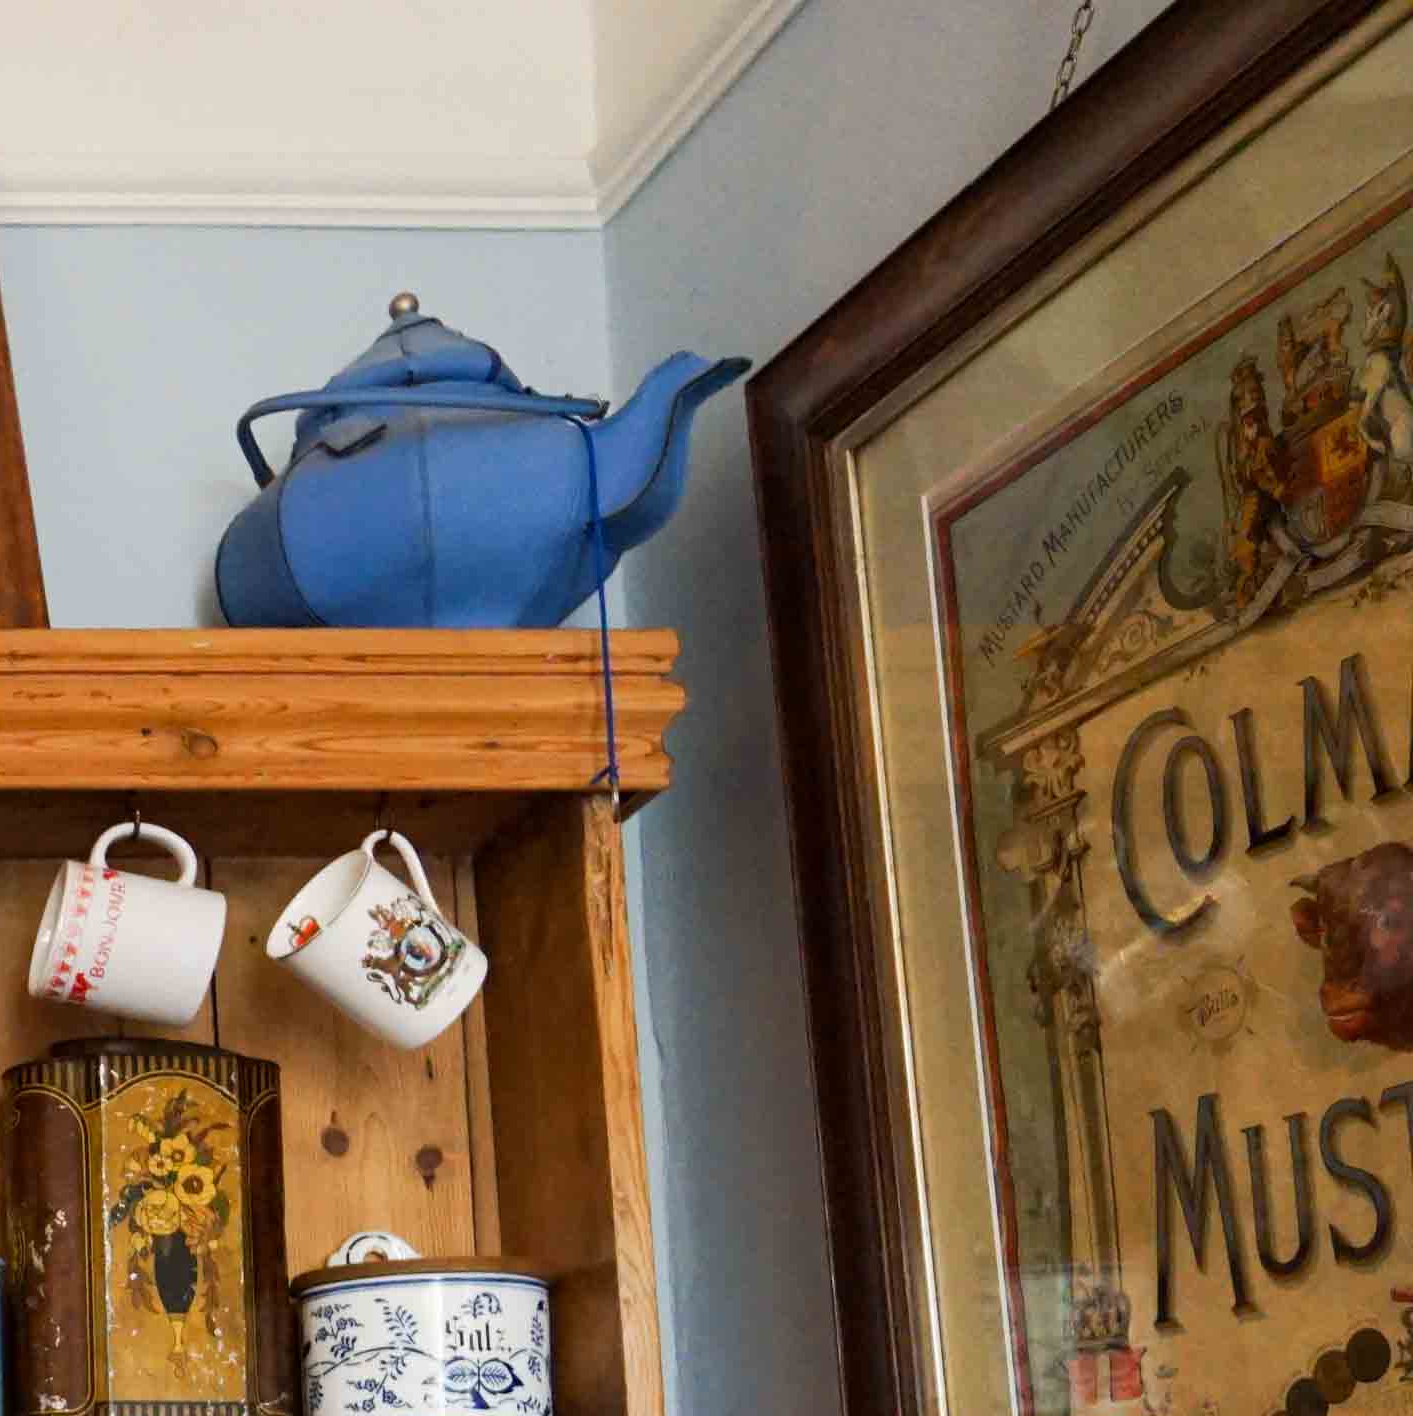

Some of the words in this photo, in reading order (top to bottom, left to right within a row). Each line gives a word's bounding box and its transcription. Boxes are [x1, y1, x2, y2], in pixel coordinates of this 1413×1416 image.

[978, 560, 1046, 664] MUSTARD
[1042, 391, 1186, 569] MANUFACTURERS
[1110, 652, 1413, 937] COLM
